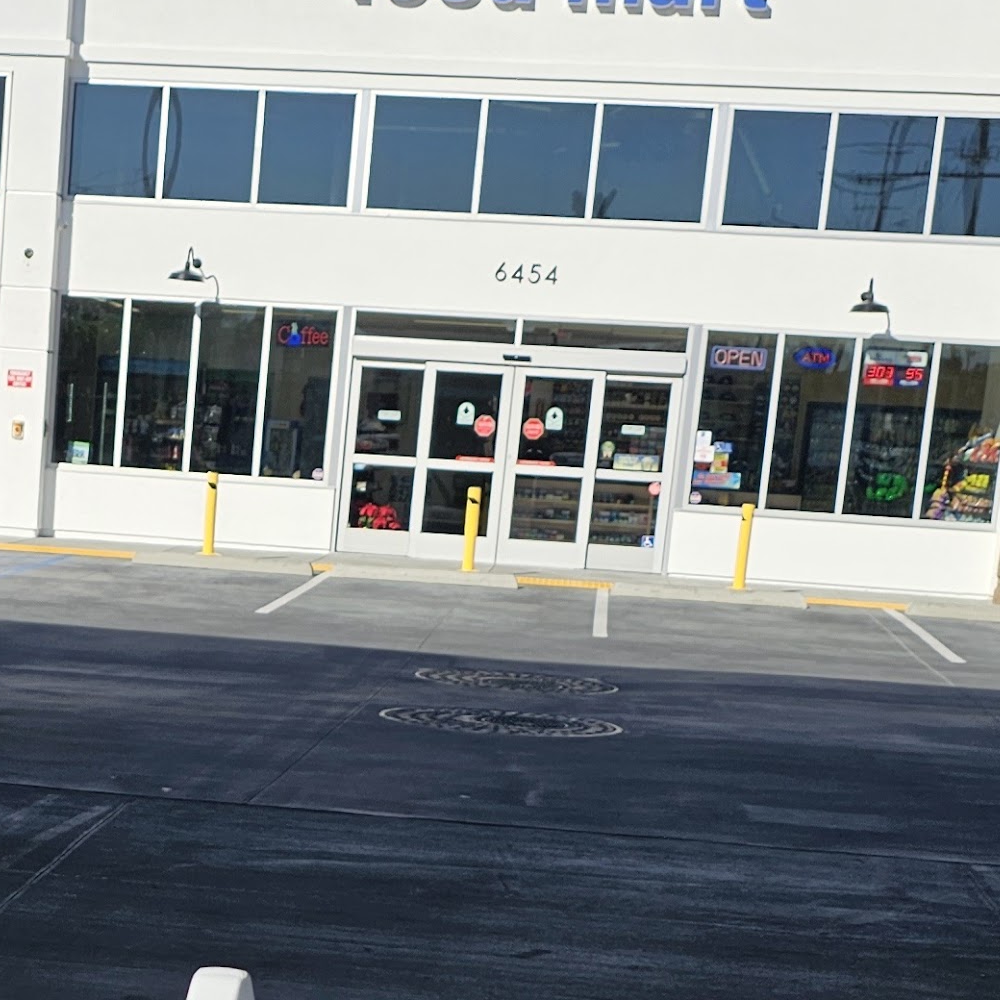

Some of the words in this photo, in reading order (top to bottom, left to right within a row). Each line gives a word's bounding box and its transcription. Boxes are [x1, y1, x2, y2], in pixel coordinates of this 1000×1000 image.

[495, 261, 558, 285] 6454
[714, 348, 764, 366] OPEN
[801, 351, 830, 364] ATM
